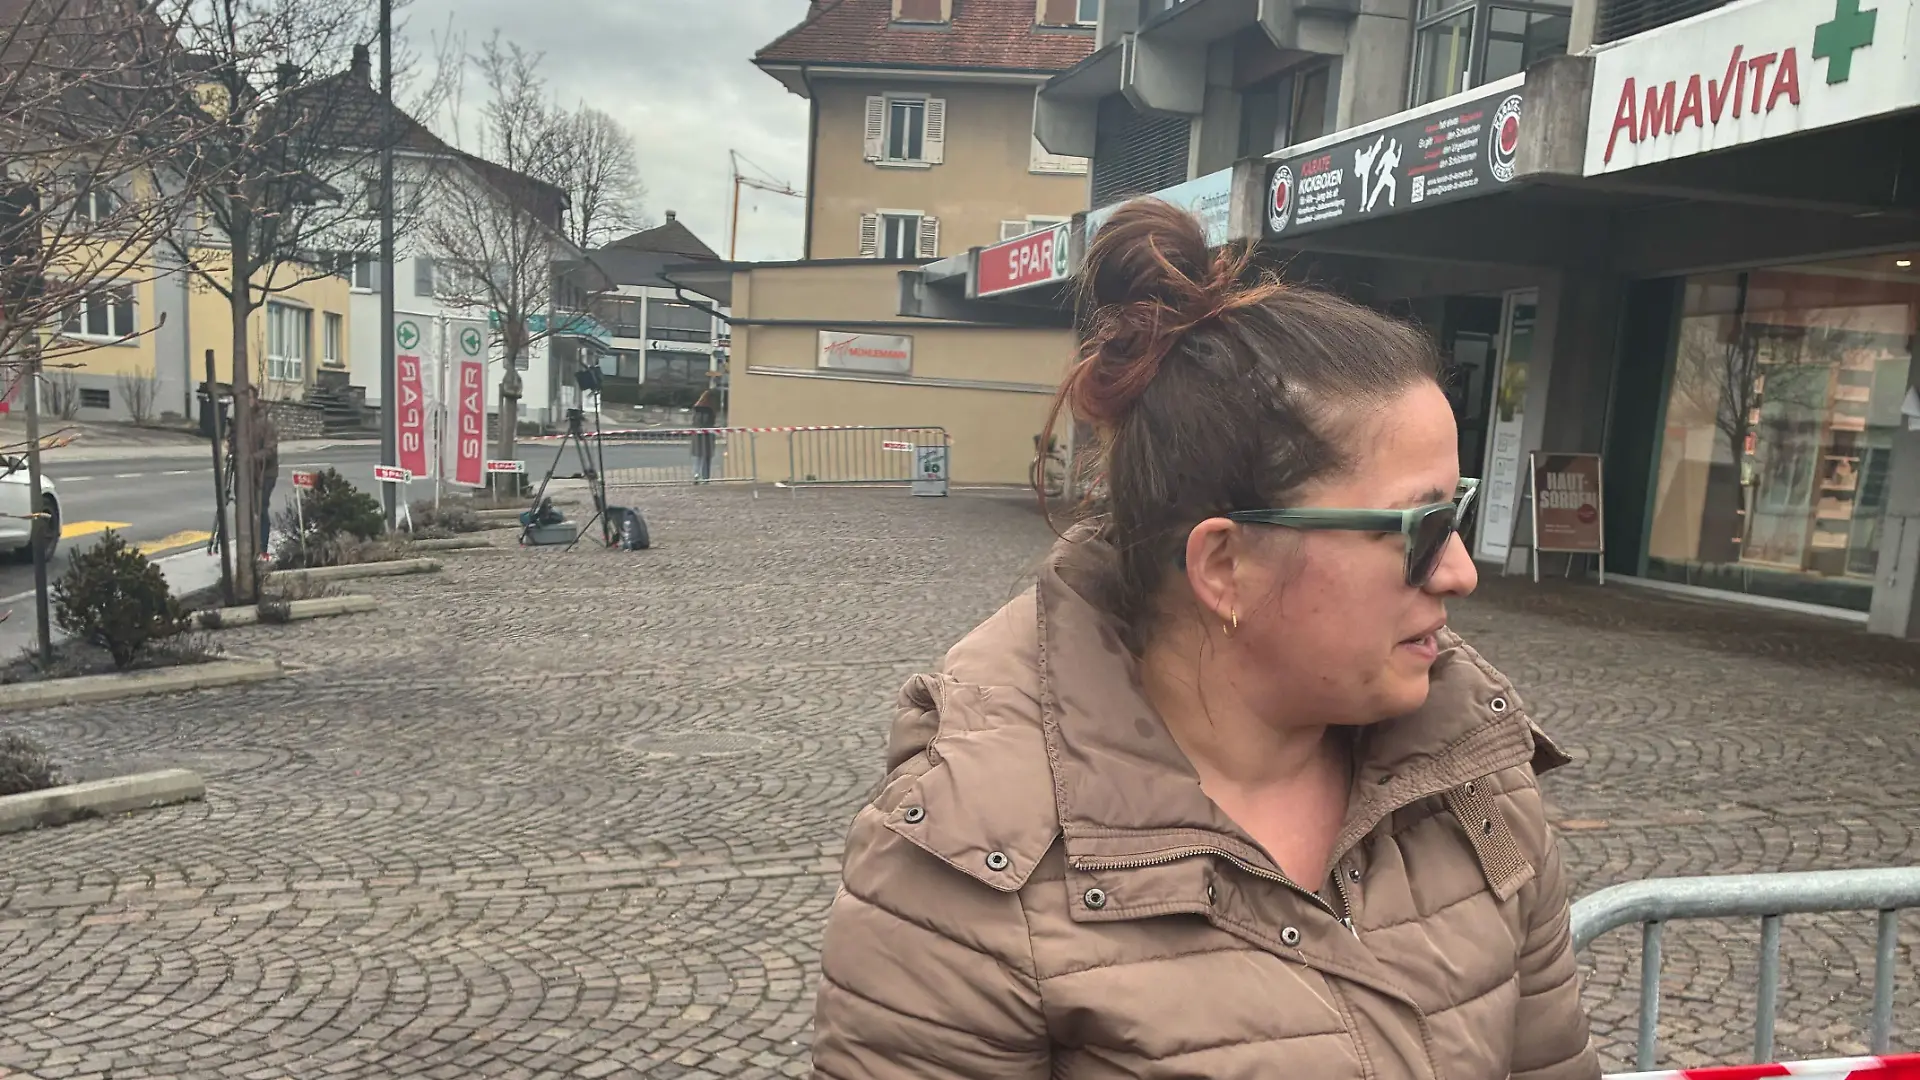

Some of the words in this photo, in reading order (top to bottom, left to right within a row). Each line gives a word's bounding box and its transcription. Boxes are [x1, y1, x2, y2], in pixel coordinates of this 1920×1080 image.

[1603, 44, 1800, 165] AMAVITA
[1008, 239, 1051, 281] SPAR
[462, 366, 479, 459] SPAR
[1546, 471, 1588, 490] HAUT-
